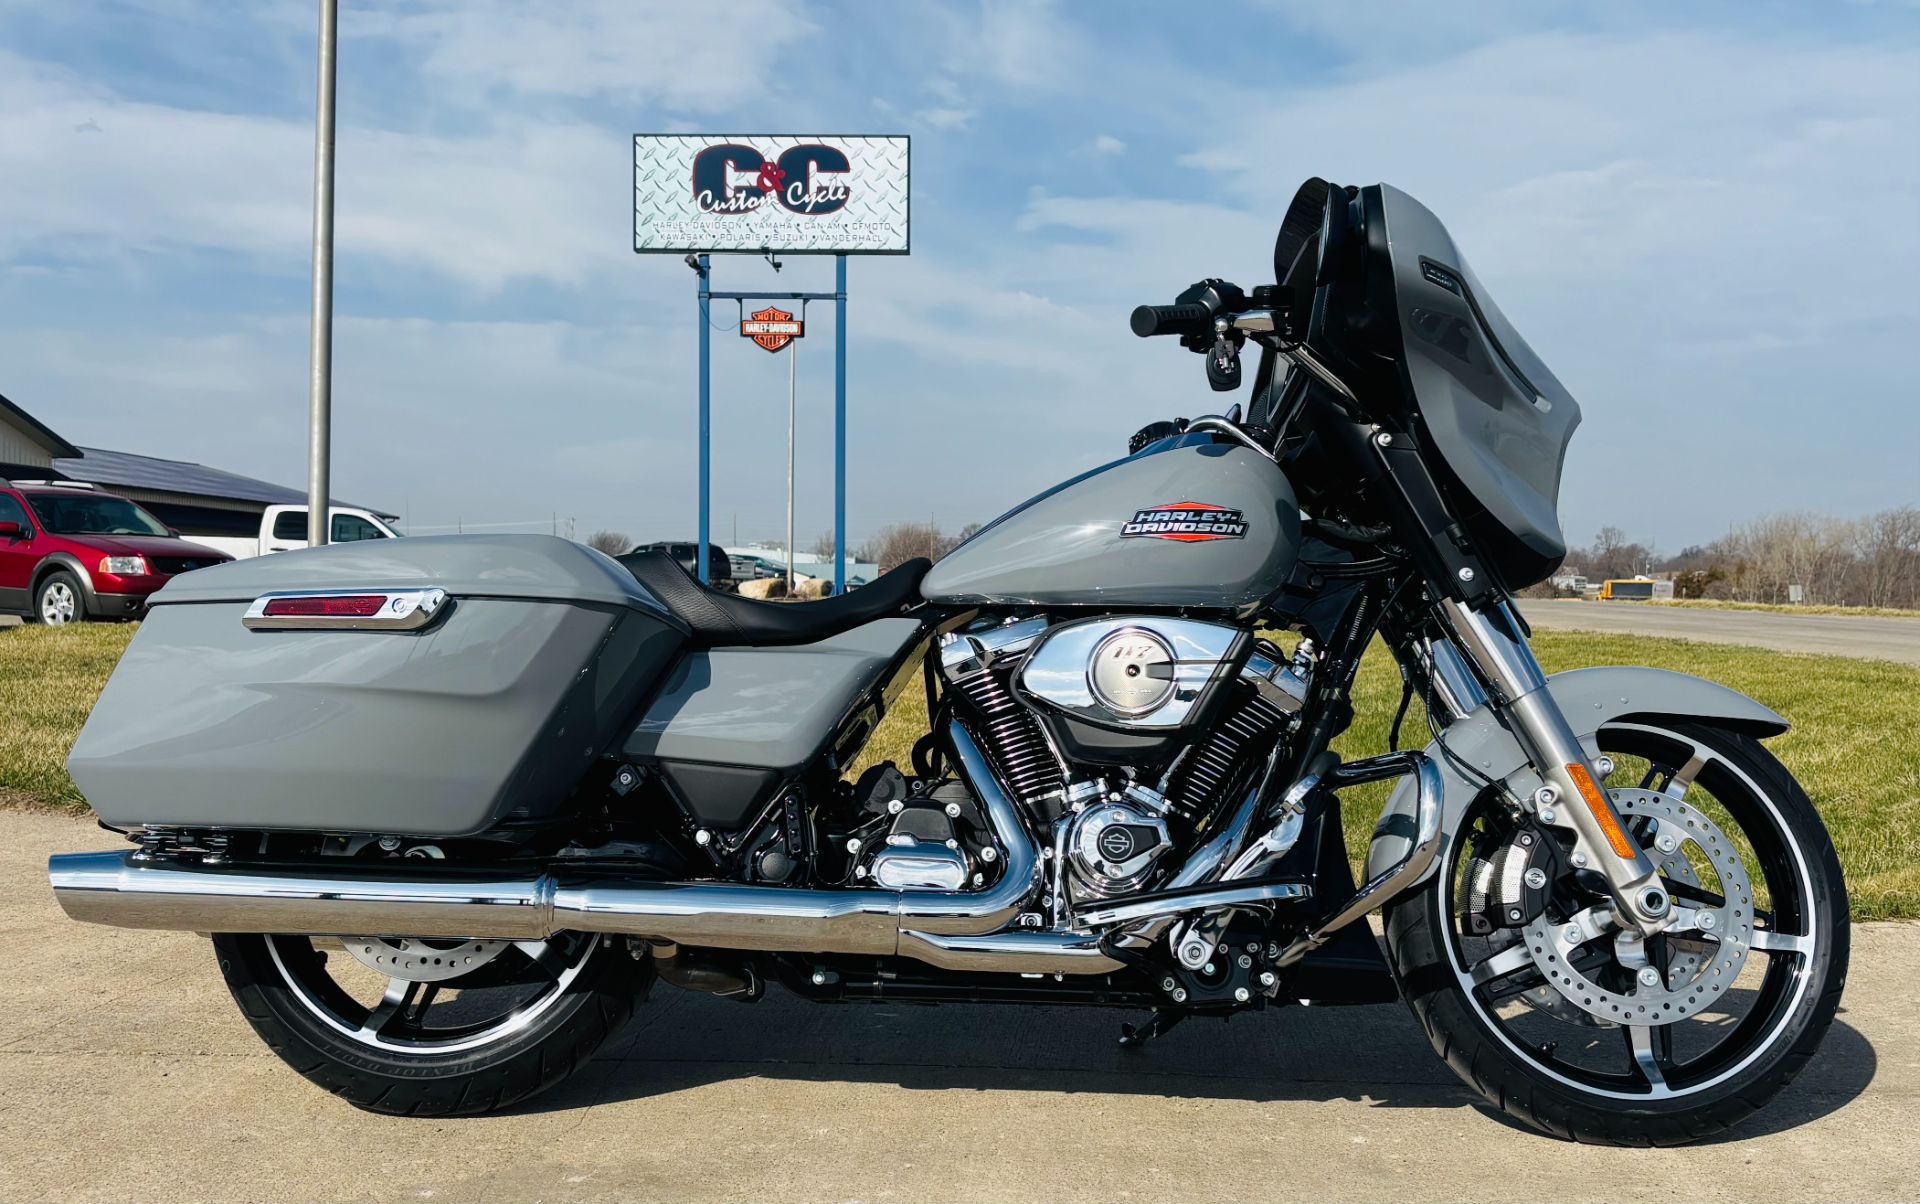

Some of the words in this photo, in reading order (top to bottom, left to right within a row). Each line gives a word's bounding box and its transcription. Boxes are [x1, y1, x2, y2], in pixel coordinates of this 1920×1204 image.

[692, 143, 851, 216] C&C
[697, 189, 779, 214] Custom
[786, 178, 848, 213] Cycle
[753, 221, 793, 230] YAMAHA
[851, 222, 892, 231] CFMOTO
[660, 233, 709, 241] KAWASAKI
[720, 233, 762, 242] POLARIS
[772, 233, 808, 242] SUZUKI
[819, 234, 883, 242] VANDERHALL
[1136, 511, 1238, 523] HARLEY-
[1124, 522, 1244, 534] DAVIDSON
